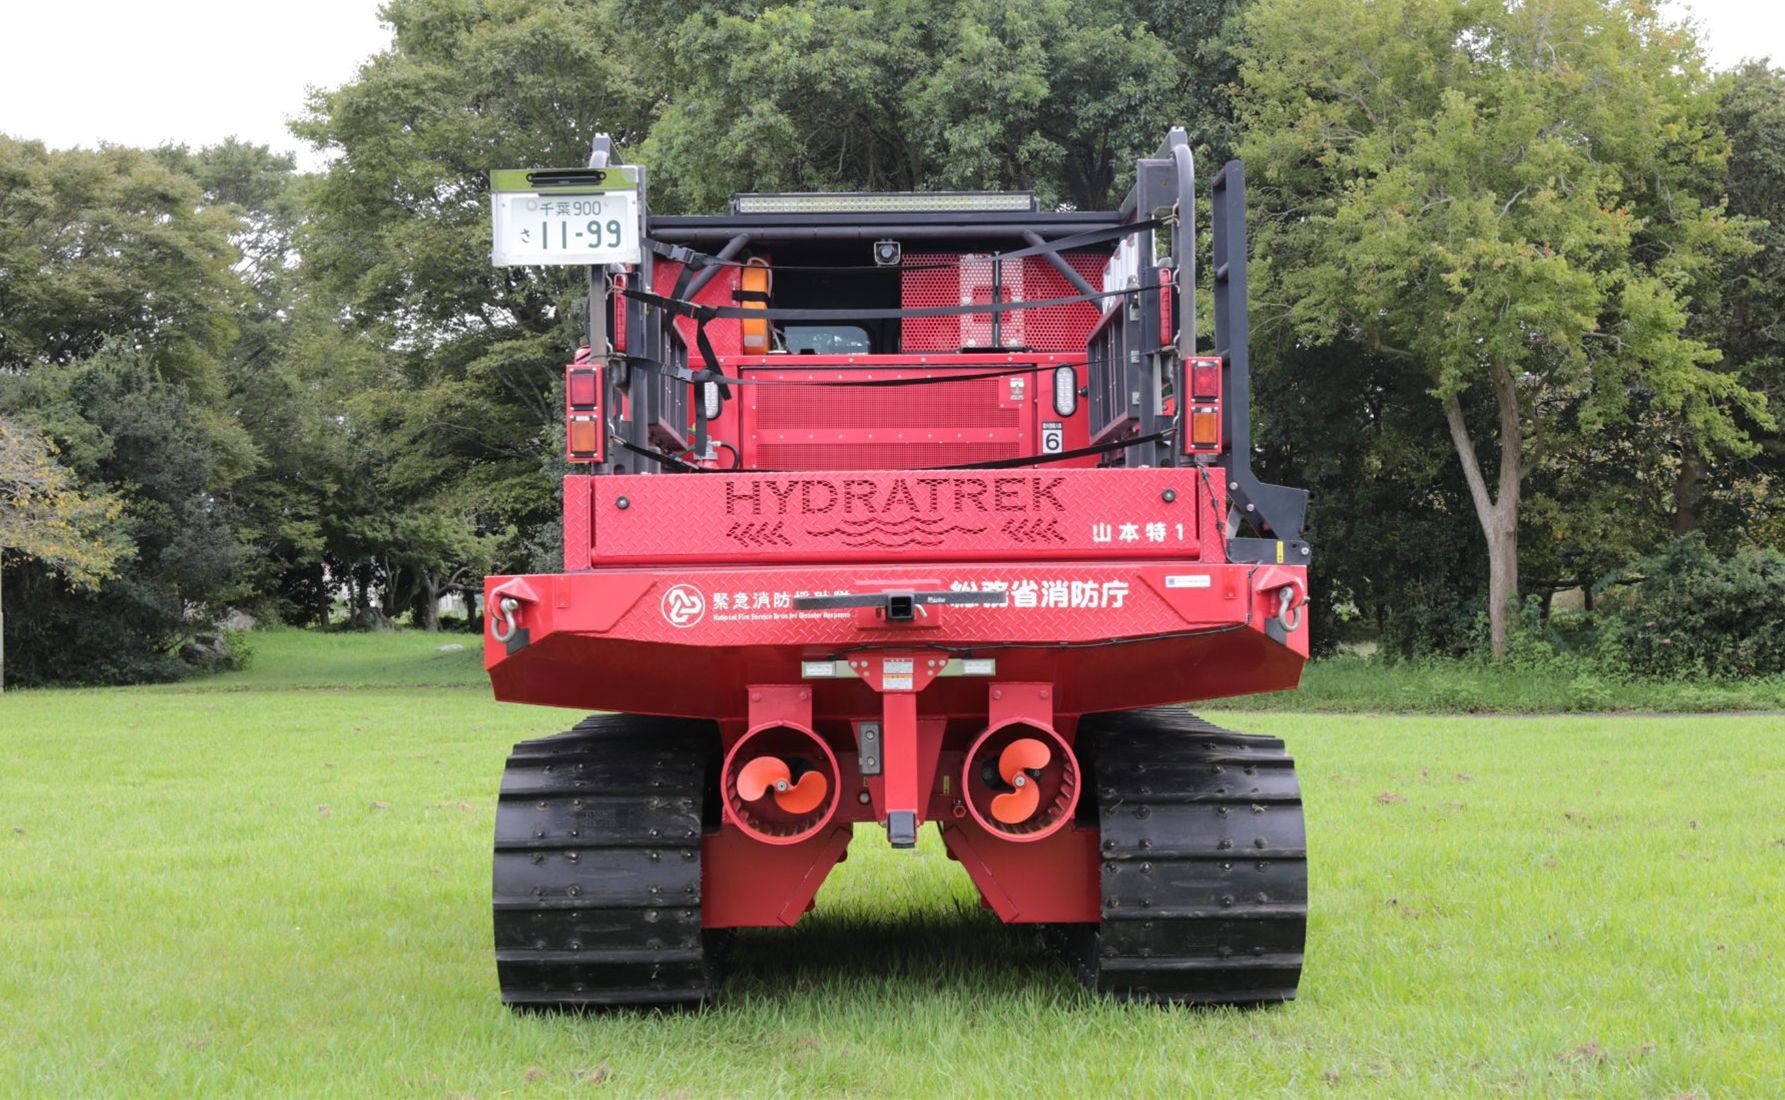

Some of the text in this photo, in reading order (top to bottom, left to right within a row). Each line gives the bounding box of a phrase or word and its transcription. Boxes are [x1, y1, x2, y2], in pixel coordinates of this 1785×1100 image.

[520, 220, 621, 249] さ 11-99
[1046, 433, 1060, 451] 6
[725, 477, 1067, 515] HYDRATREK
